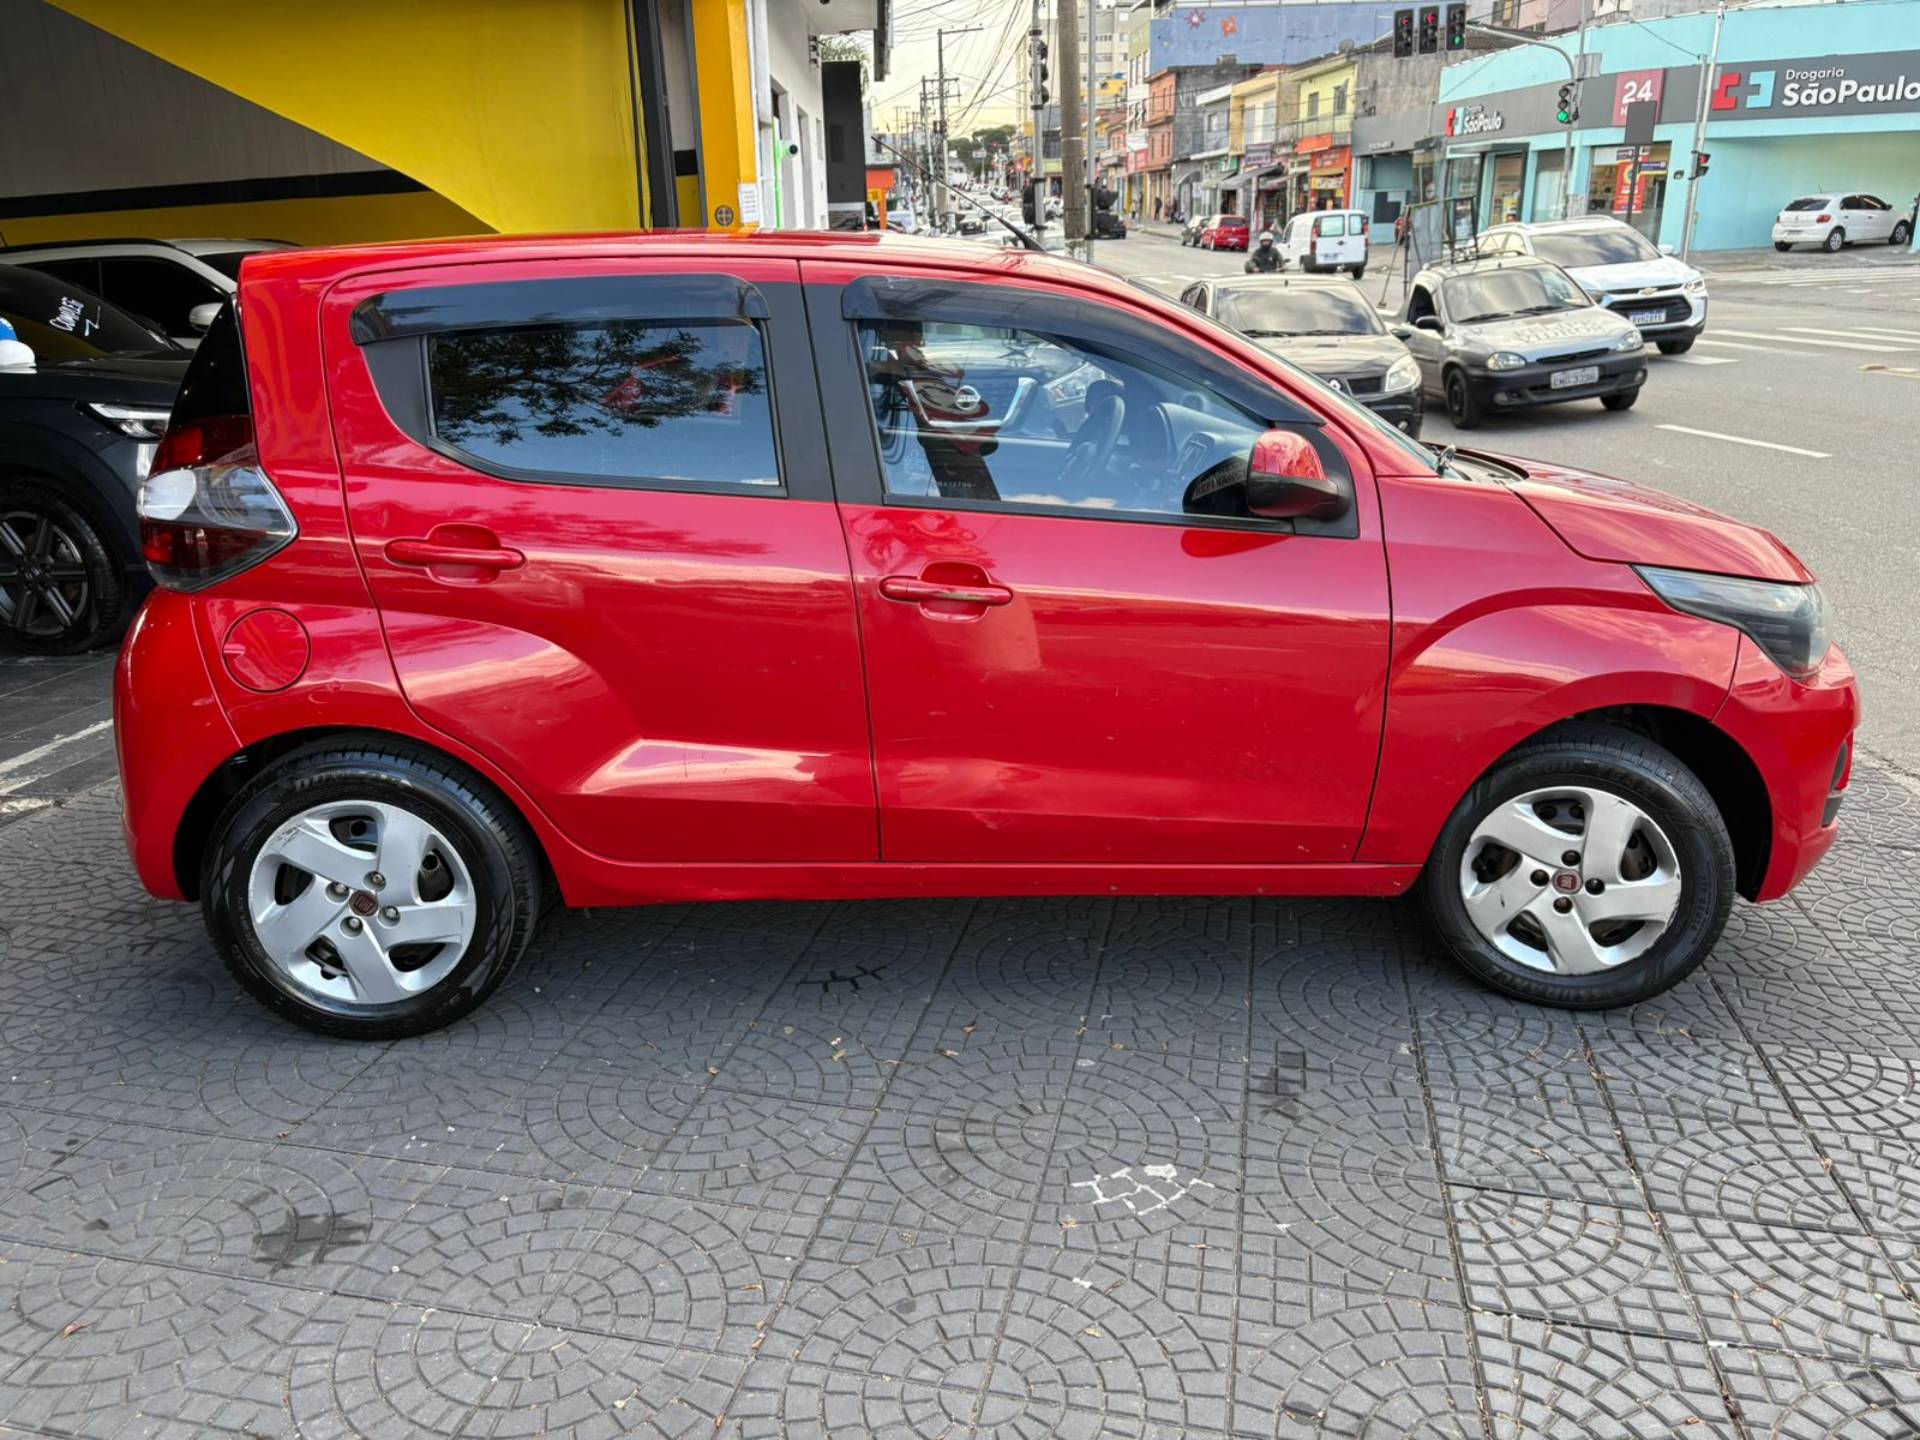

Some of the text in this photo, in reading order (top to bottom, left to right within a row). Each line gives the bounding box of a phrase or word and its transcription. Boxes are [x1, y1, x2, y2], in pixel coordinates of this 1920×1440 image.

[1785, 67, 1844, 81] Drogaria
[1622, 80, 1653, 104] 24
[1782, 75, 1920, 107] SãoPaulo
